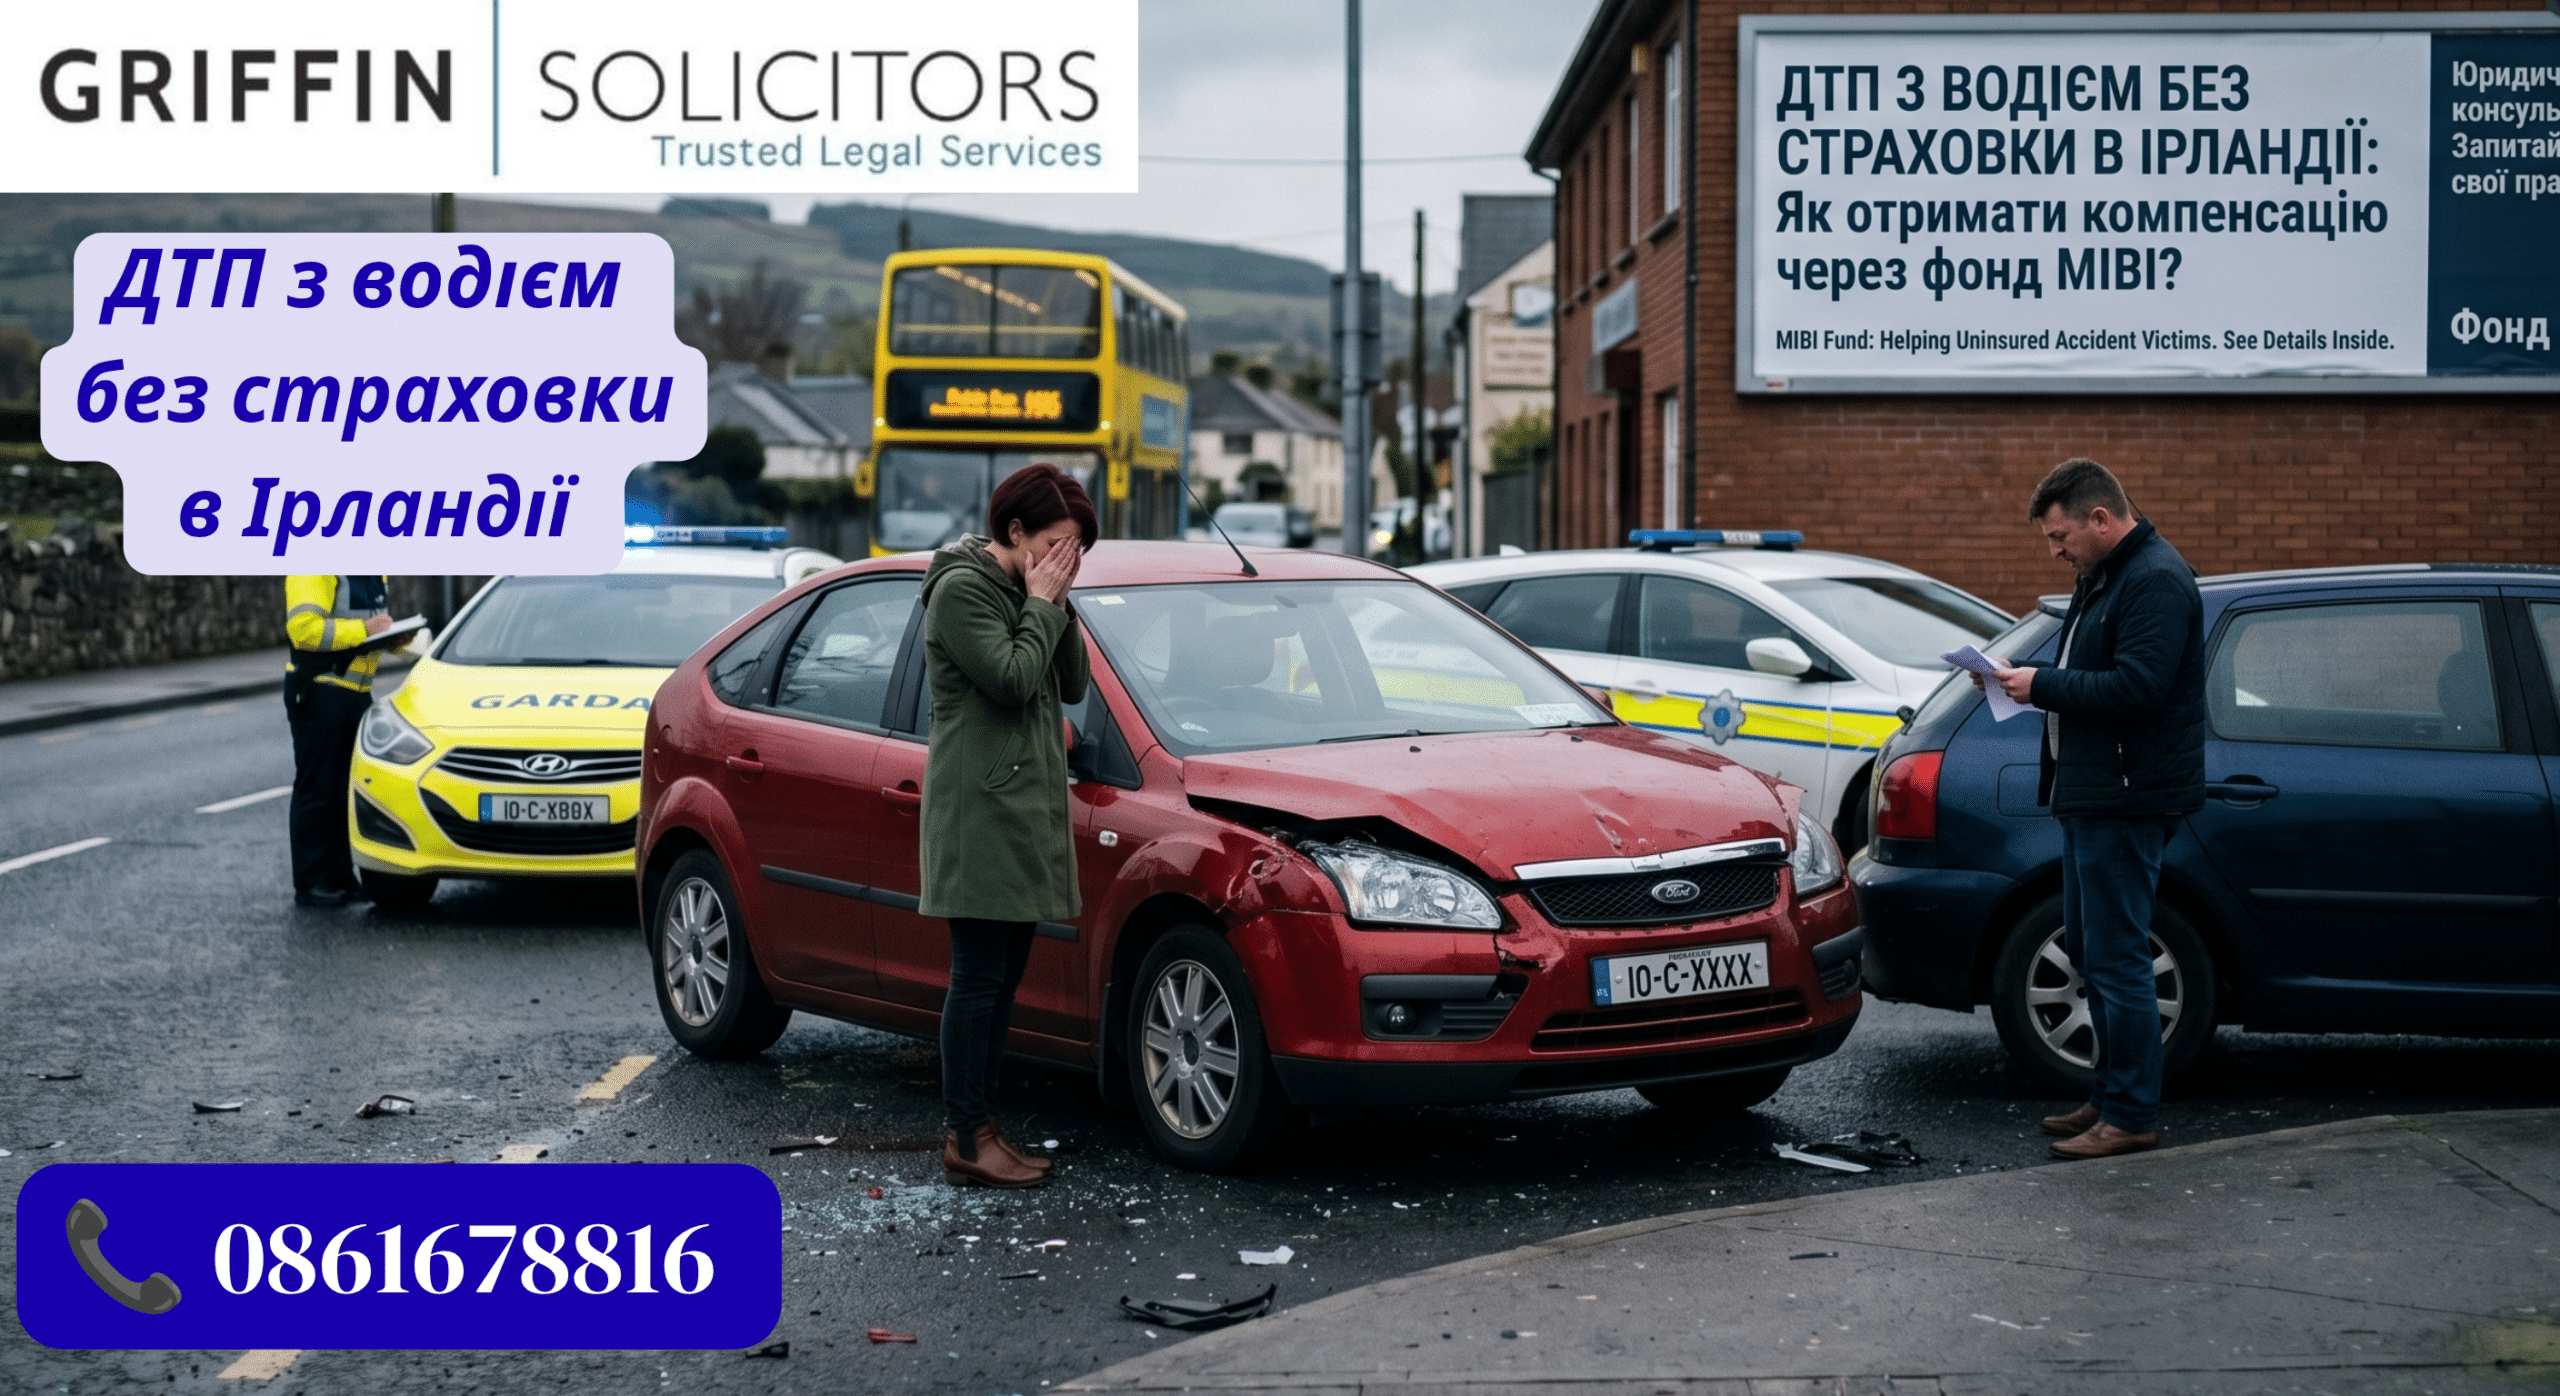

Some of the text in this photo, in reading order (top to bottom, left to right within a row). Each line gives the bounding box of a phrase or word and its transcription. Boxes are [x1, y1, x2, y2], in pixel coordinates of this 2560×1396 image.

[1776, 64, 2250, 122] ДТП З ВОДІЄМ БЕЗ
[2452, 60, 2560, 93] Юридич
[1776, 118, 2380, 185] СТРАХОВКИ В ІРЛАНДІЇ:
[2451, 168, 2509, 194] свої
[1776, 188, 2388, 242] Як отримати компенсацію
[1777, 257, 1907, 302] через
[1922, 245, 2043, 302] фонд
[1776, 328, 2395, 356] MIBI Fund: Helping Uninsured Accident Victims. See Details Inside.
[2450, 307, 2550, 351] Фонд
[471, 693, 652, 712] GARDA
[1627, 952, 1754, 999] 10-C-XXXX
